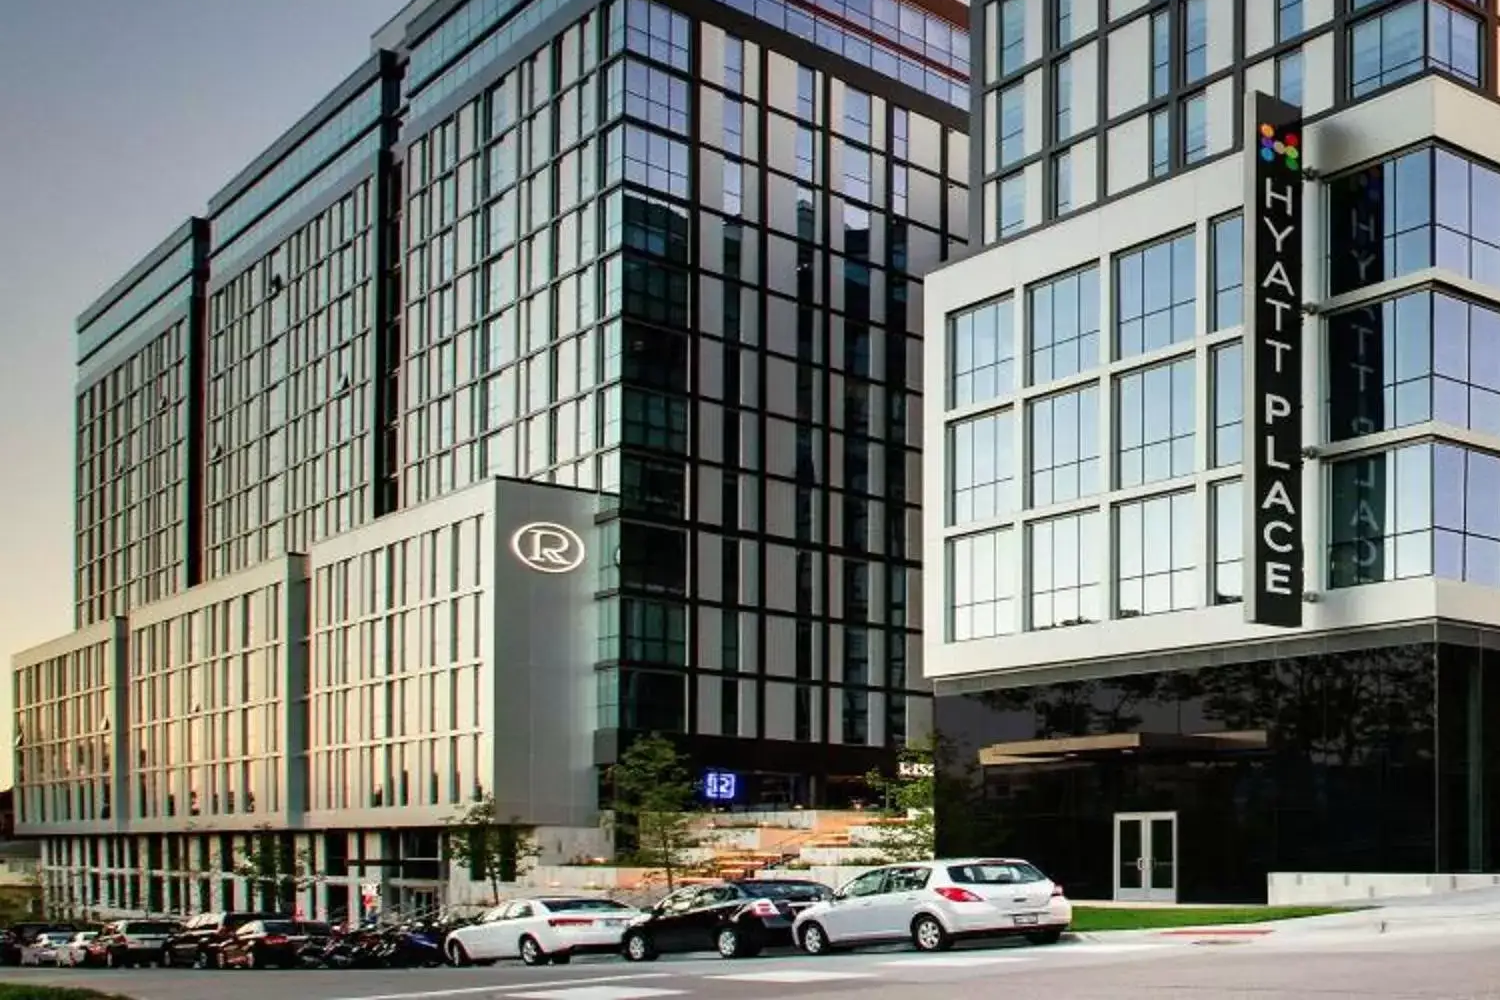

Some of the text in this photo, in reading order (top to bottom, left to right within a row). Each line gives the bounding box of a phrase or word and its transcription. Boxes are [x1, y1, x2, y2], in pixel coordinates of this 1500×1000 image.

[1261, 177, 1296, 596] HYATT PLACE
[525, 526, 574, 567] R
